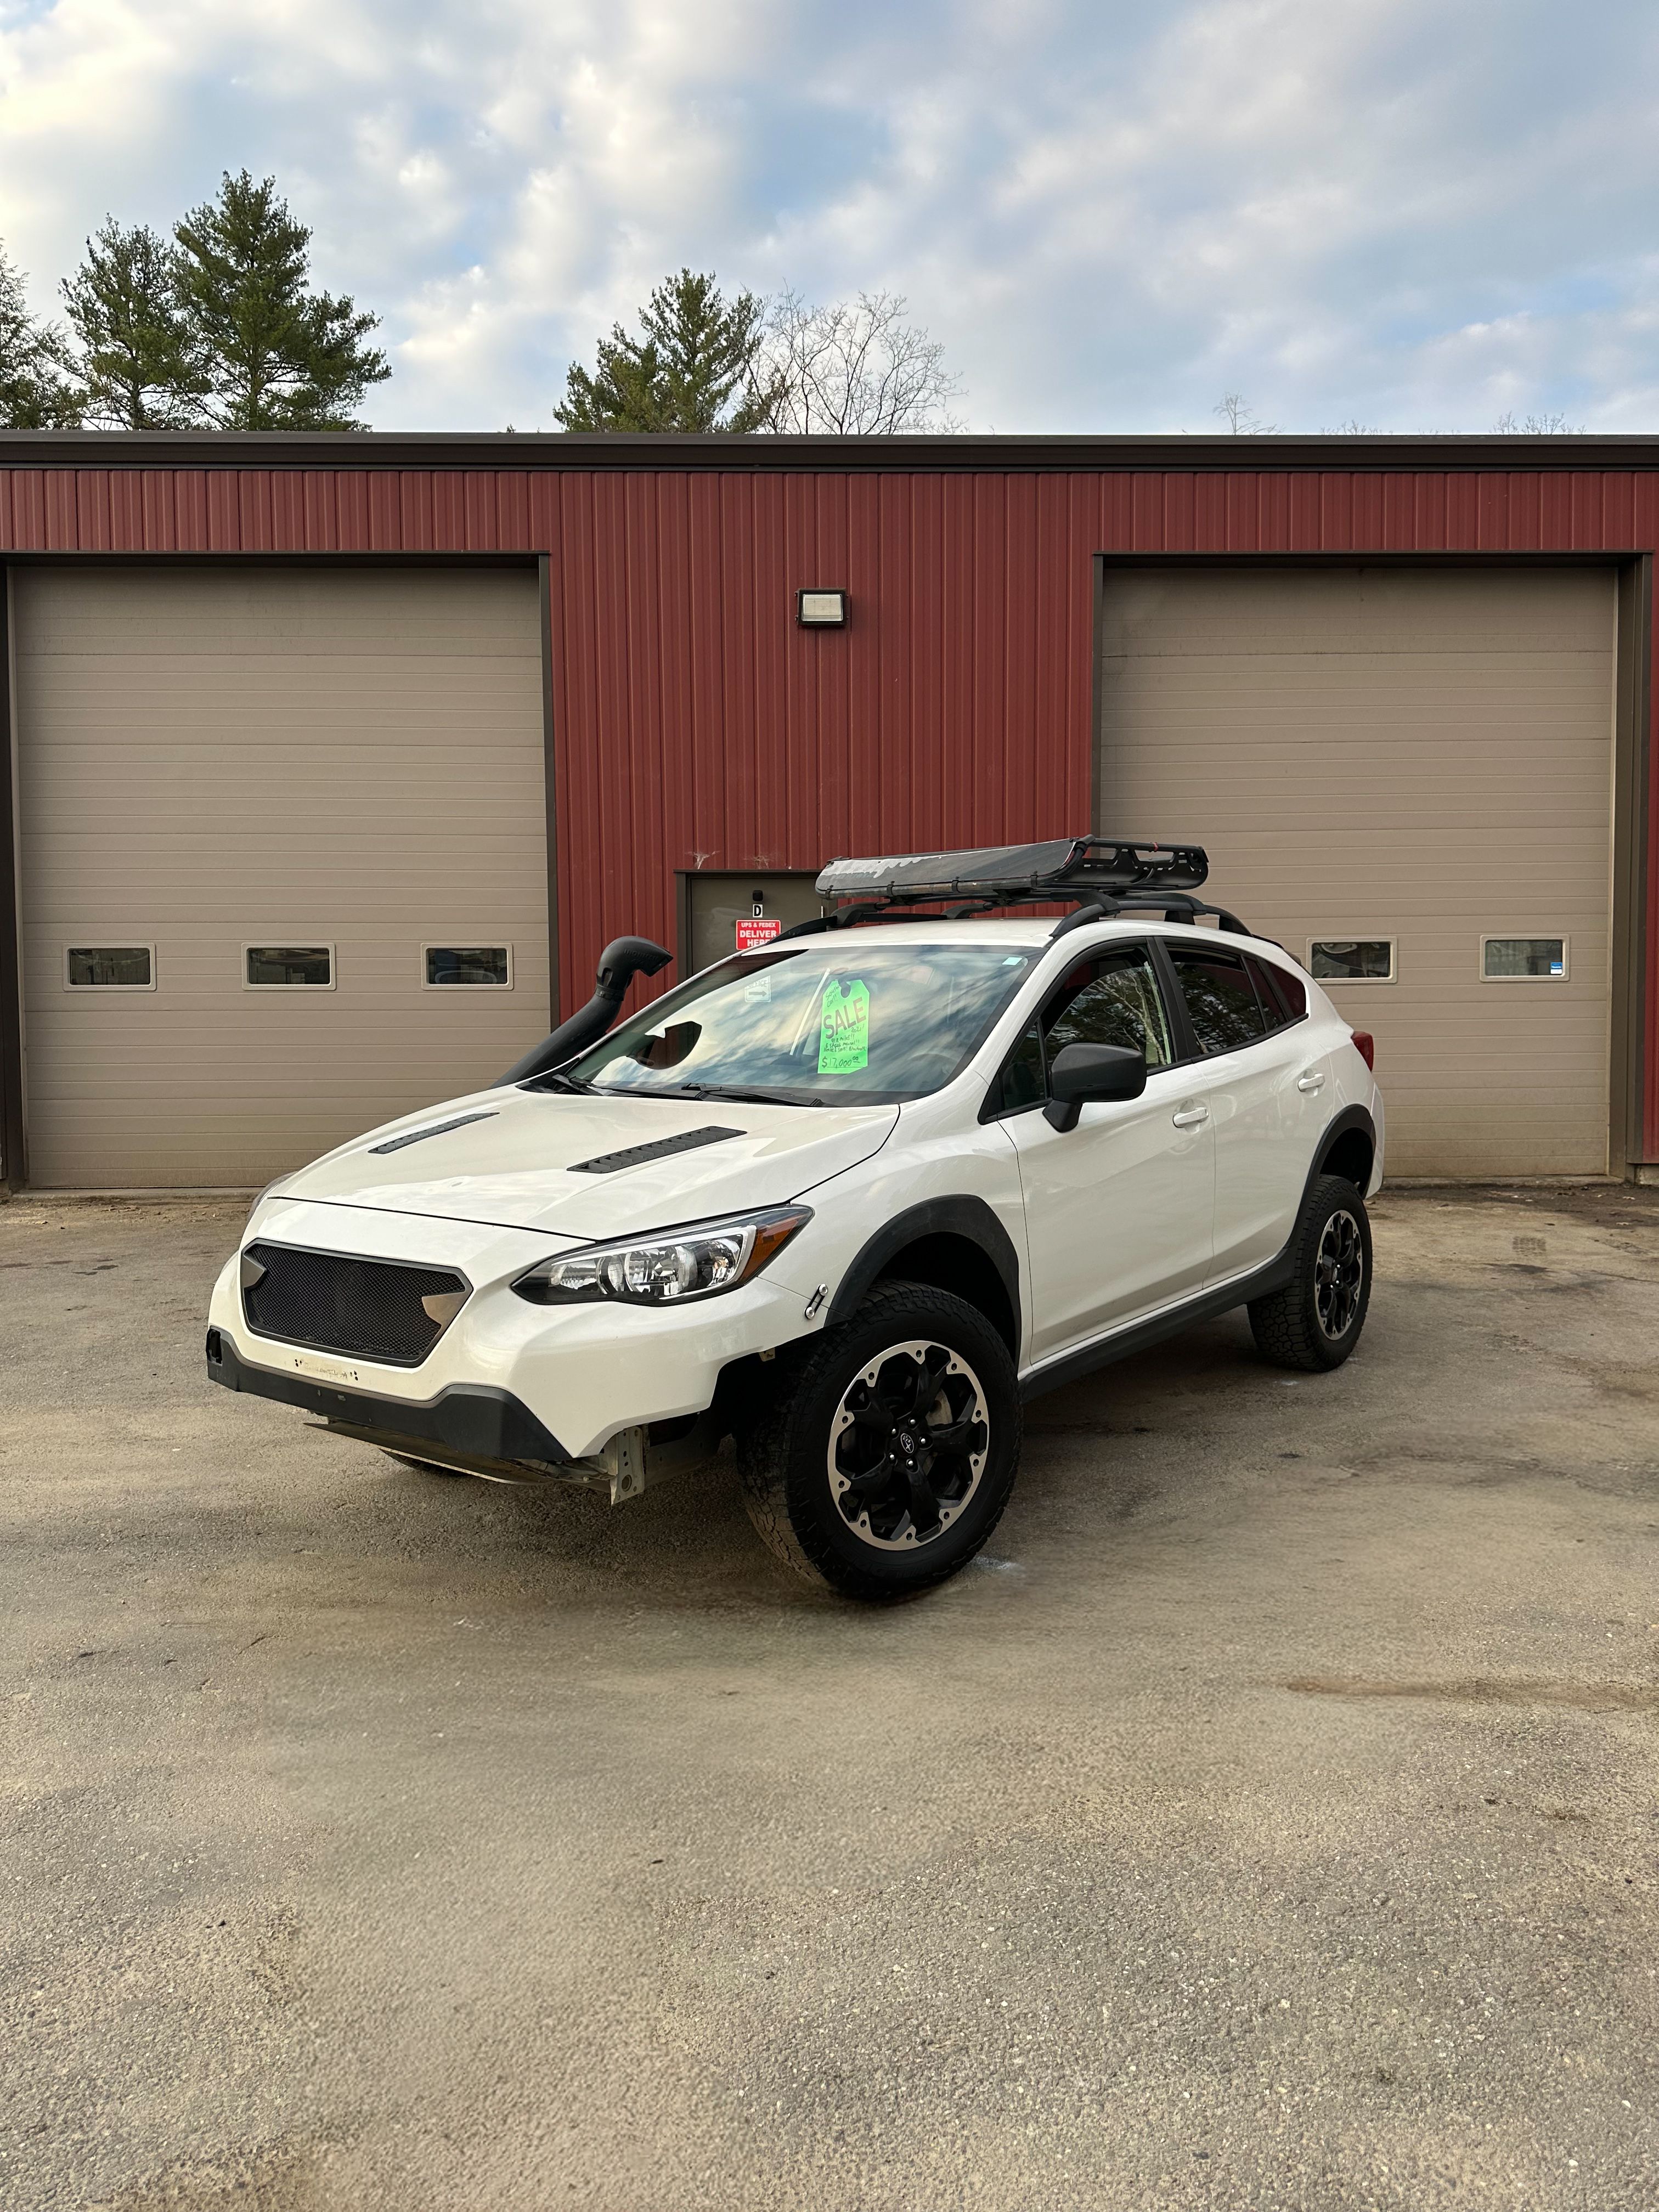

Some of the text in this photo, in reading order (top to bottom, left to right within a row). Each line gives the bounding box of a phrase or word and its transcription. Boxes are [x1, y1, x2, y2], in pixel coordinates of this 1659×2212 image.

[754, 905, 761, 917] D
[740, 930, 777, 938] DELIVER
[823, 997, 866, 1039] SALE
